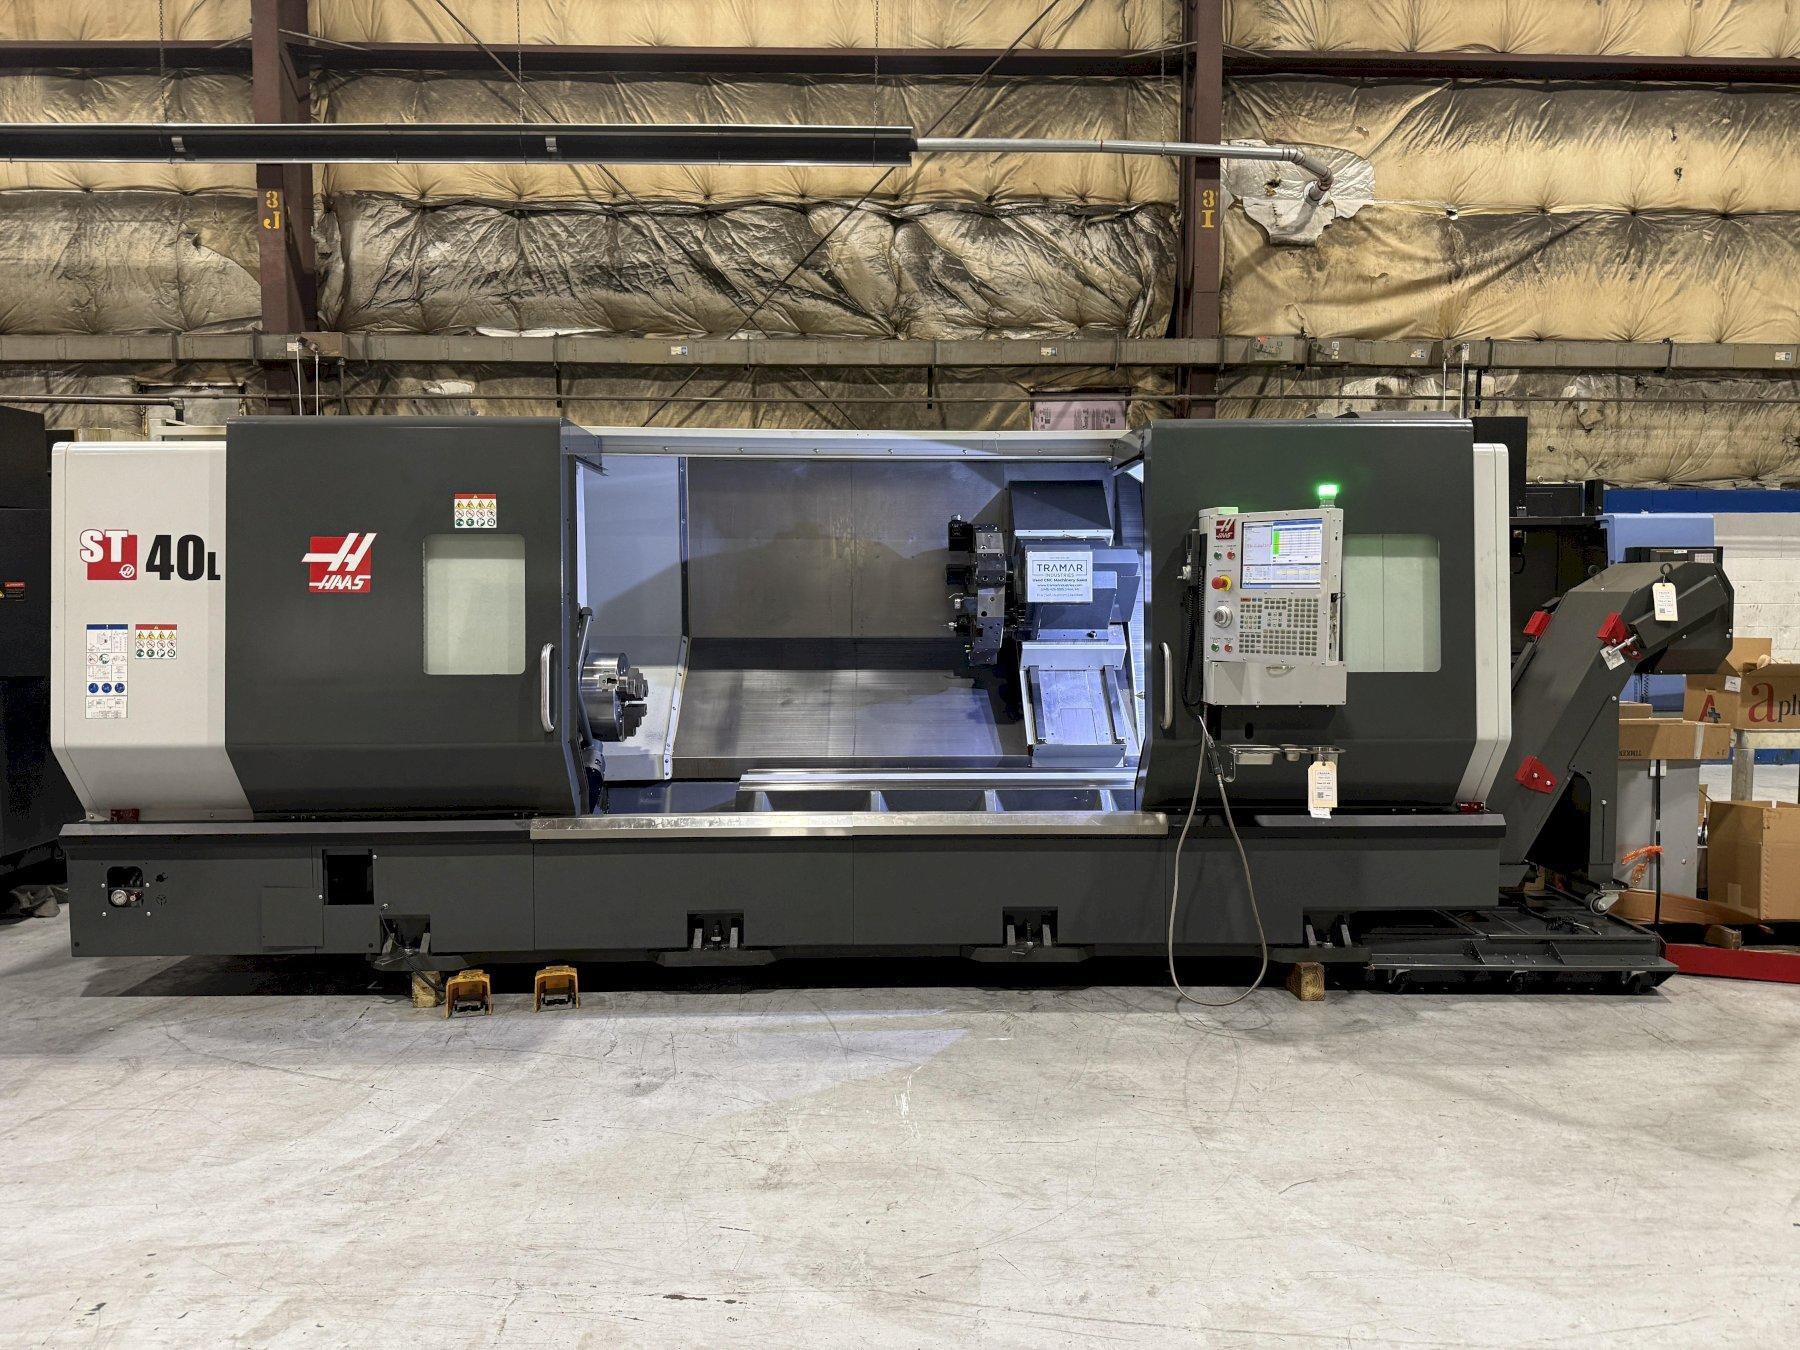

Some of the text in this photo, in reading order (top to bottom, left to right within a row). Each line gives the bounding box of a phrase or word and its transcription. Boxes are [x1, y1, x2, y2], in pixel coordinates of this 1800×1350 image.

[265, 190, 279, 208] 3
[1202, 190, 1215, 208] 3
[263, 210, 281, 230] J
[79, 528, 129, 563] ST
[308, 574, 372, 590] HAAS
